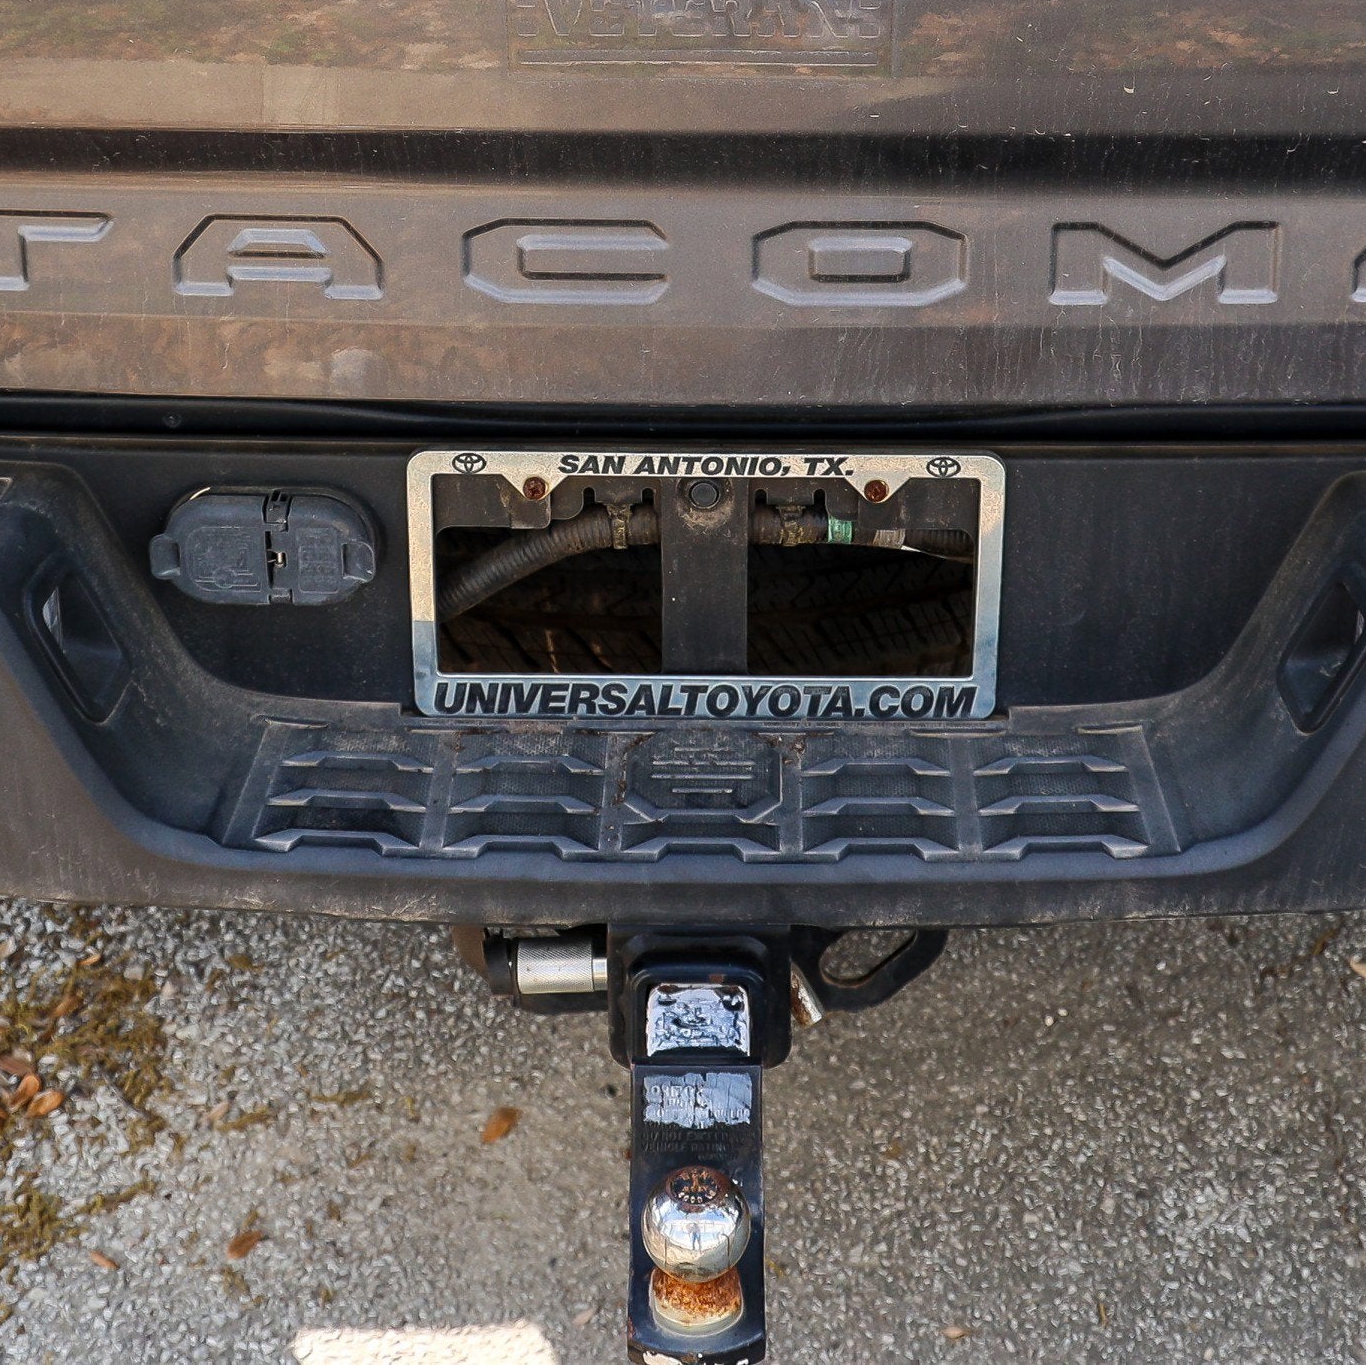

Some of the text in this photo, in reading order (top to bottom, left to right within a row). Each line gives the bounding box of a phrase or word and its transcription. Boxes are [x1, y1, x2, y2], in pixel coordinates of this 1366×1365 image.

[557, 454, 855, 478] SAN ANTONIO, TX.
[434, 681, 979, 718] UNIVERSALTOYOTA.COM
